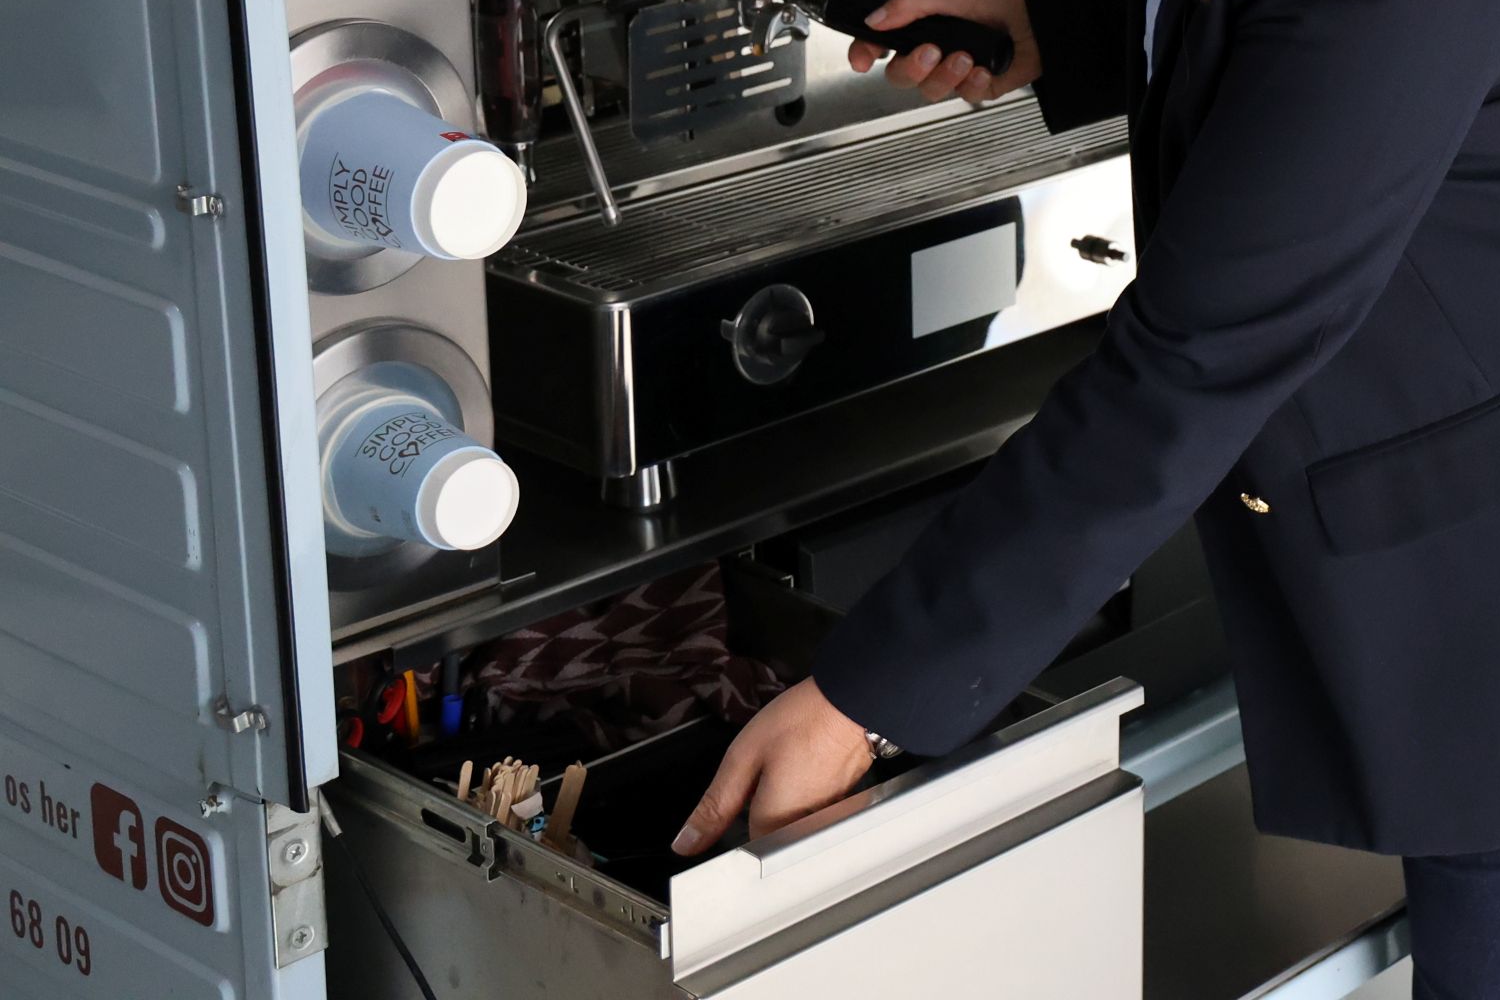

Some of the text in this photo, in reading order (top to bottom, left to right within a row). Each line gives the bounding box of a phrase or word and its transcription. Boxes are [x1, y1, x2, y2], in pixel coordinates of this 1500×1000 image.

[363, 413, 428, 458] SIMPLY
[379, 422, 442, 462] GOOD
[5, 775, 32, 815] os
[40, 780, 81, 839] her
[10, 889, 91, 976] 68 09
